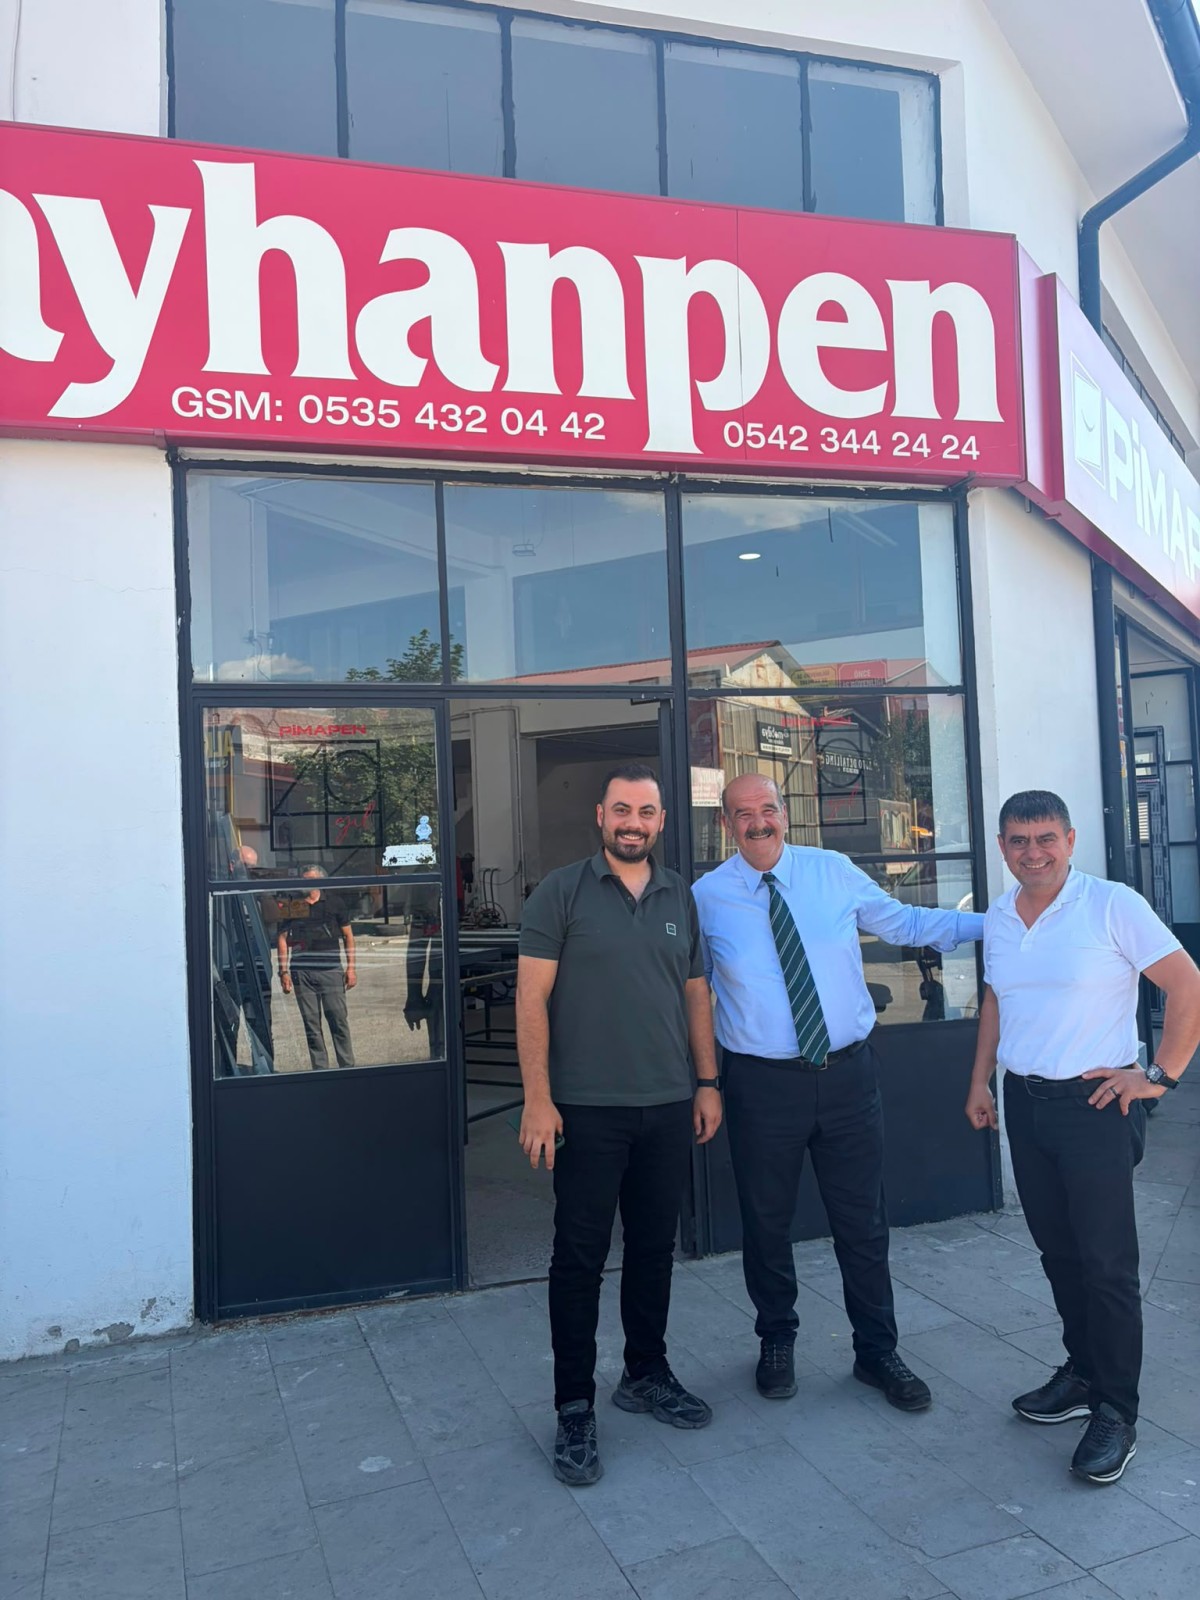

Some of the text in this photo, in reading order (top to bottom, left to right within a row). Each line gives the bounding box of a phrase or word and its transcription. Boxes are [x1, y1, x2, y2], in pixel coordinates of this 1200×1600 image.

[171, 386, 606, 440] GSM: 0535 432 04 42
[723, 421, 980, 460] 0542 344 24 24
